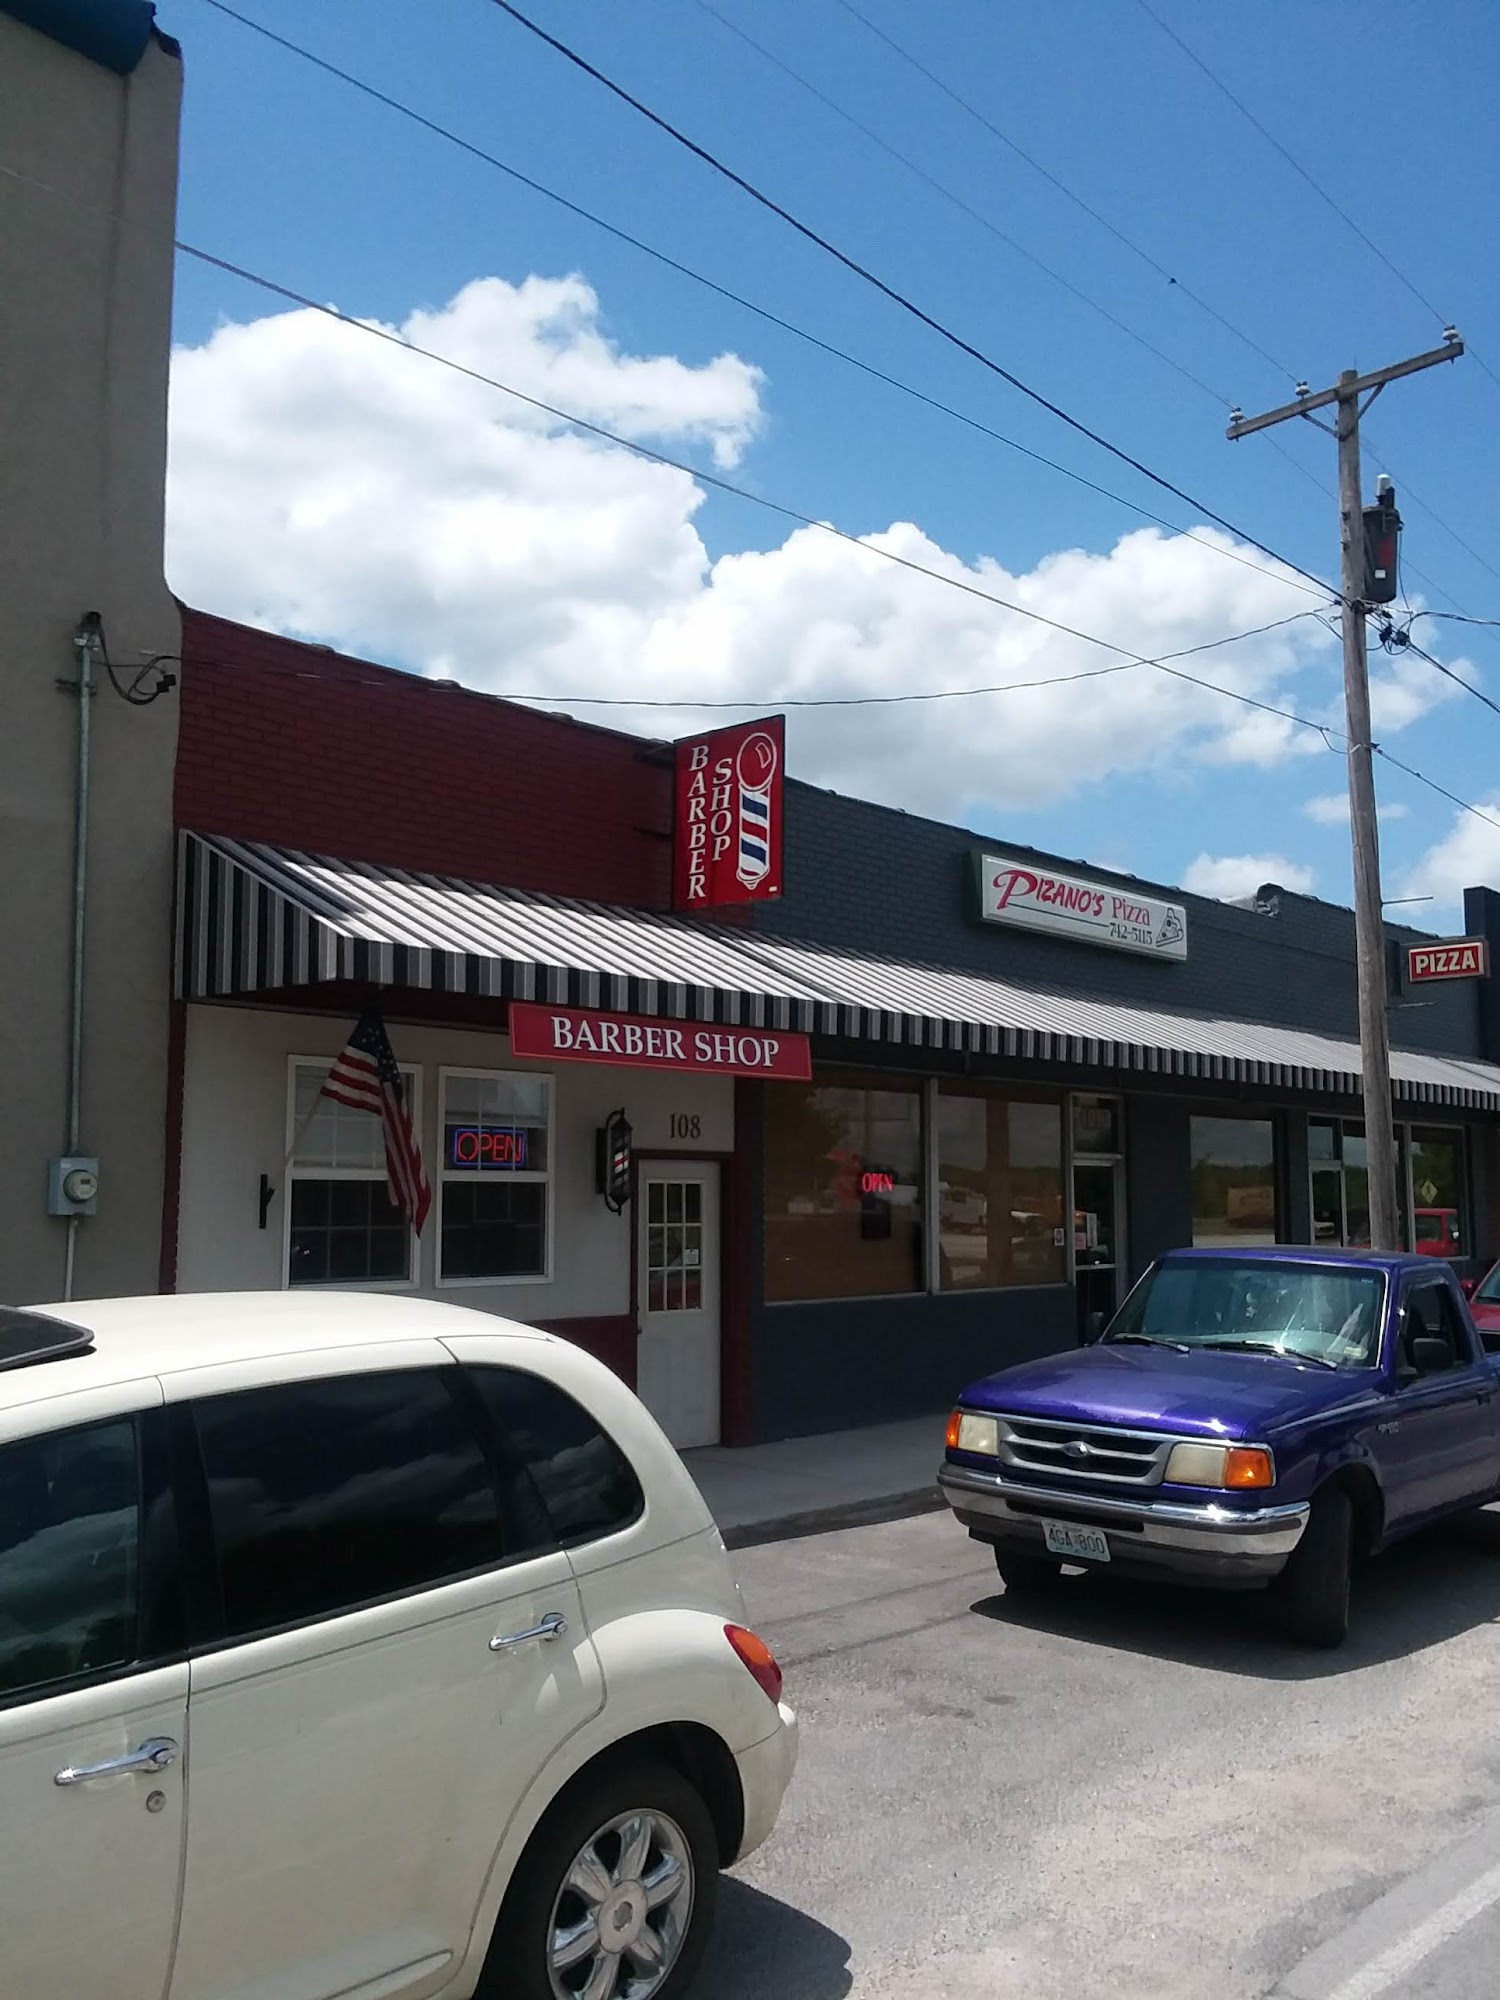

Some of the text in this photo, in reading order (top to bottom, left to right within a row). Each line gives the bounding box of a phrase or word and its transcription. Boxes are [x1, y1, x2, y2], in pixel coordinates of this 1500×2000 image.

[687, 745, 709, 900] BARBER
[710, 758, 733, 861] SHOP
[1109, 922, 1153, 946] 742-5115
[1415, 950, 1476, 974] PIZZA
[551, 1015, 780, 1067] BARBER SHOP
[669, 1113, 701, 1140] 108
[456, 1132, 523, 1162] OPEN
[861, 1172, 894, 1193] OPEN
